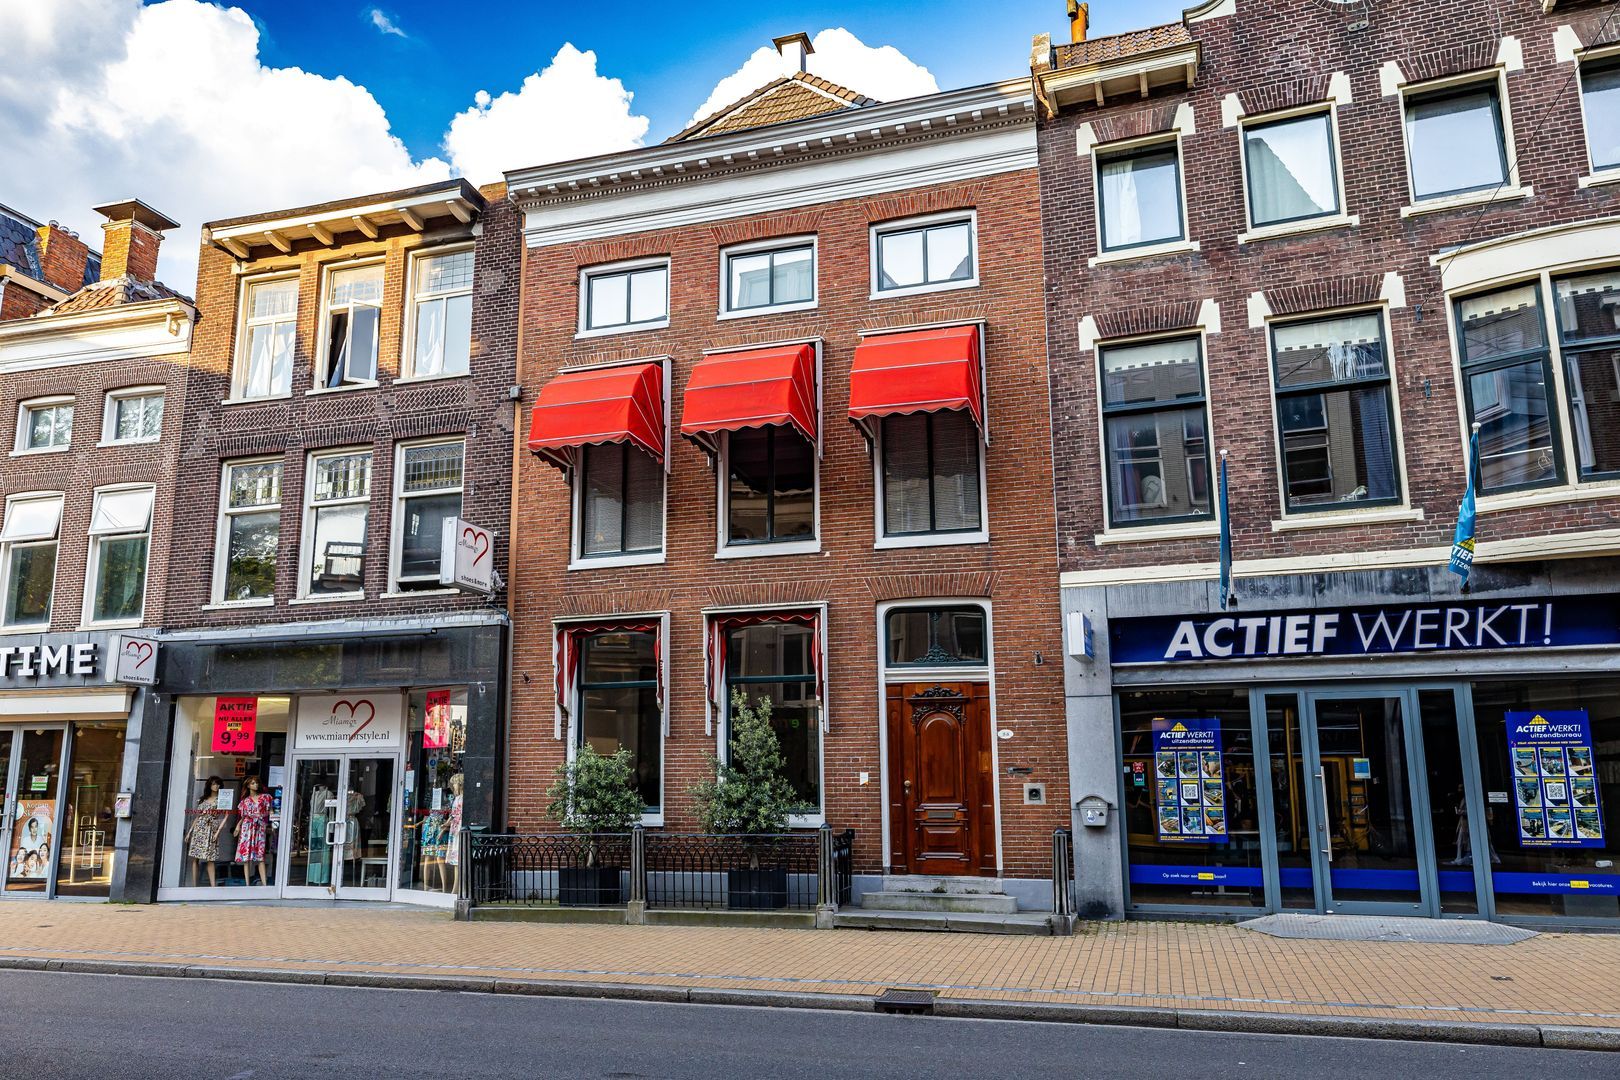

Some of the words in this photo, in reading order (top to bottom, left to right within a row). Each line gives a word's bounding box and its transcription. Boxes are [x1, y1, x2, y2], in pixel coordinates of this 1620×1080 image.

[1451, 545, 1474, 561] TIEF
[1164, 613, 1339, 658] ACTIEF
[1352, 603, 1553, 652] WERKT!
[0, 643, 94, 677] TIME
[220, 703, 253, 711] AKTIE
[1515, 725, 1547, 733] ACTIEF
[1548, 724, 1581, 732] WERKT!
